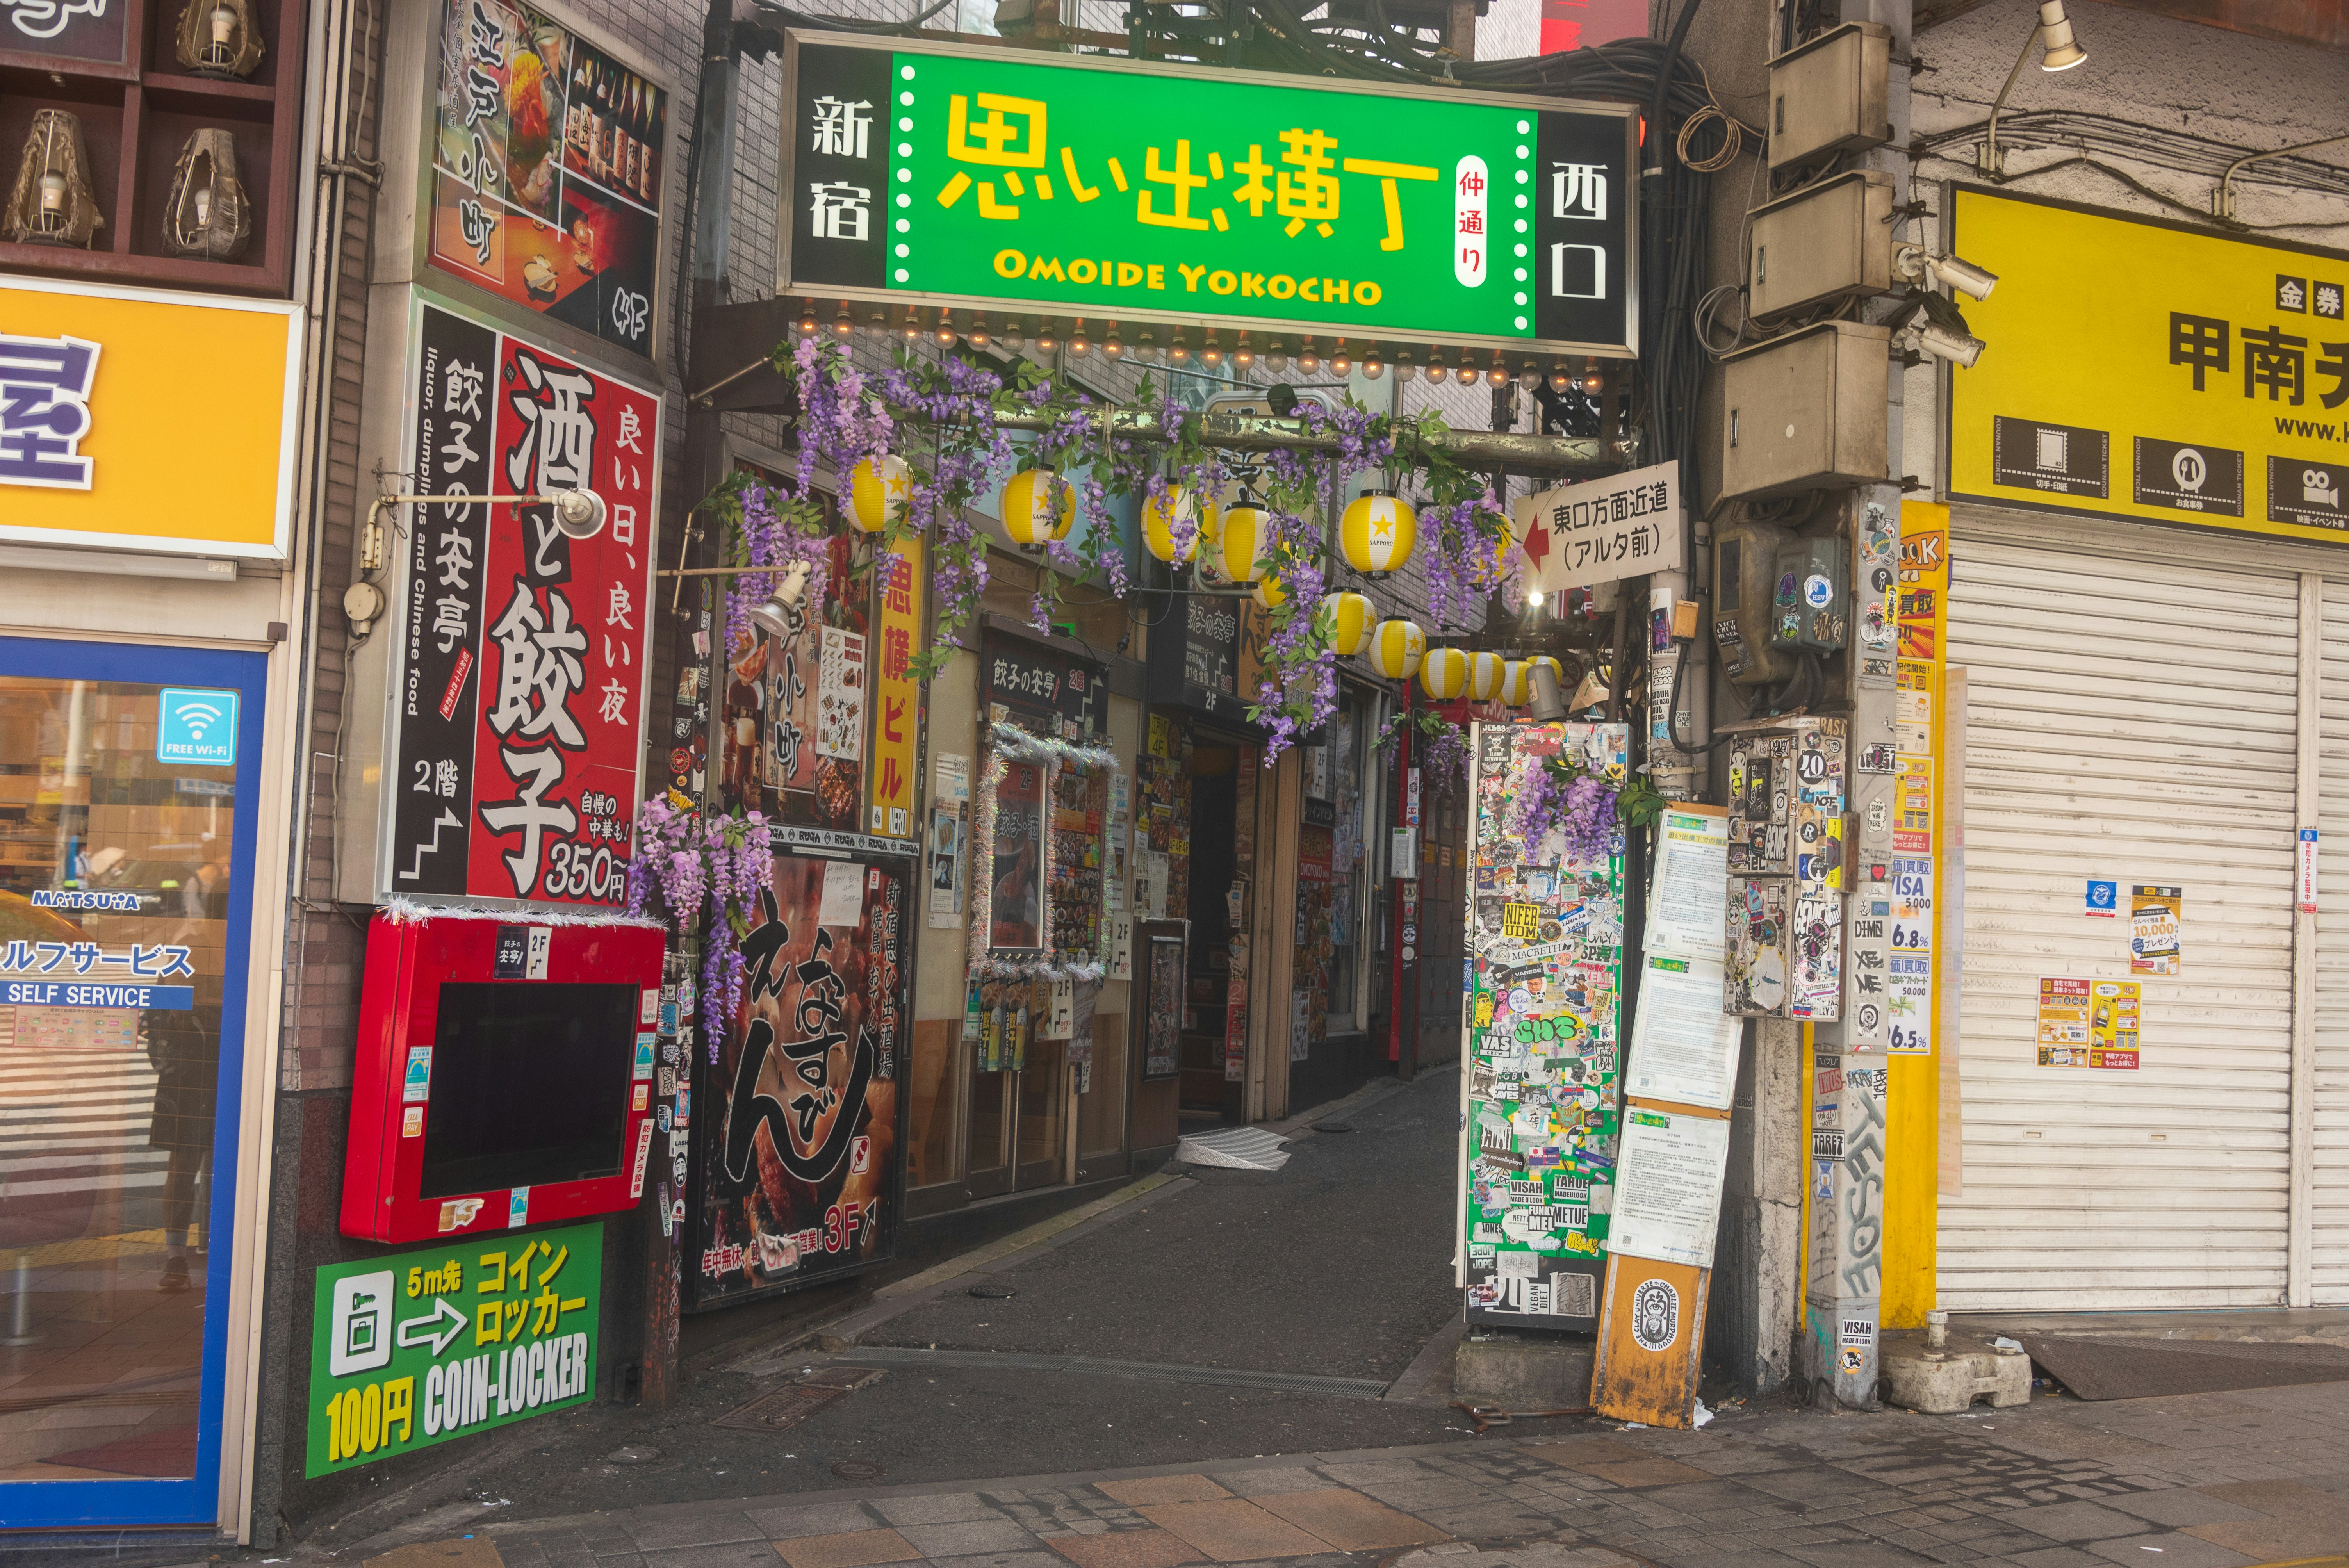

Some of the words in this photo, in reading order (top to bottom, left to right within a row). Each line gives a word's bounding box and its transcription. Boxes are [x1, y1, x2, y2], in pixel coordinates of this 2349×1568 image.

[810, 95, 873, 241] 新宿
[937, 92, 1439, 251] 思い出横丁
[1459, 171, 1484, 272] 仲通り
[1551, 161, 1608, 300] 西口
[993, 249, 1165, 291] OMOIDE
[1177, 262, 1382, 306] YOKOCHO
[424, 346, 438, 410] liquor,
[2035, 478, 2068, 492] 切手・印紙
[433, 358, 483, 653] 餃子の安亭
[1552, 480, 1668, 535] 東口方面近道
[2176, 498, 2203, 510] お食事券
[2297, 514, 2345, 529] 映画・イベント券
[415, 535, 426, 572] and
[1564, 523, 1659, 571] (アルタ前)
[597, 404, 644, 725] 良い日、良い夜
[1899, 593, 1932, 615] 買取
[411, 580, 426, 661] Chinese
[479, 349, 595, 895] 酒と餃子
[994, 658, 1055, 698] 餃子の安亭
[1727, 663, 1740, 672] AVOID
[880, 559, 913, 801] 思横ビル
[1069, 668, 1085, 693] 2階
[407, 668, 421, 716] food
[1205, 691, 1217, 711] 2F
[1300, 722, 1308, 739] 4F
[166, 743, 193, 755] FREE
[196, 745, 227, 756] Wi-Fi
[1152, 737, 1164, 755] 4F
[1318, 753, 1325, 767] 2F
[413, 759, 459, 798] 2階
[1020, 768, 1032, 790] 2F
[581, 791, 617, 816] 自慢の
[1871, 804, 1884, 813] JASON
[888, 807, 907, 836] NERO
[1765, 825, 1788, 860] GENIE
[1300, 862, 1322, 878] OMOYOKO
[1506, 904, 1538, 926] NIFER
[1564, 910, 1577, 918] VISITOR
[1117, 924, 1128, 940] 2F
[1505, 925, 1537, 938] UDM
[2133, 923, 2174, 938] 10,000
[2145, 935, 2178, 948] プレゼント!
[532, 935, 547, 952] 2F
[1511, 943, 1561, 960] MACBETH
[0, 940, 195, 977] ルフサービス
[499, 949, 520, 963] 安亭
[878, 878, 900, 1078] 新宿思ひ出酒場
[1514, 968, 1542, 976] VARESE
[9, 984, 58, 1003] SELF
[66, 986, 151, 1007] SERVICE
[1058, 979, 1069, 996] 2F
[1481, 1036, 1510, 1050] VAS
[1082, 1066, 1089, 1076] 2F
[1819, 1070, 1842, 1093] IWOS
[406, 1124, 419, 1132] PAY
[634, 1124, 651, 1193] 防犯カメラ設置
[1510, 1181, 1543, 1194] VISAH
[1554, 1190, 1587, 1199] MADEULOOK
[1529, 1205, 1554, 1216] FUNKY
[824, 1201, 859, 1254] 3F
[1529, 1216, 1554, 1231] MEL
[478, 1240, 568, 1294] コイン
[1473, 1258, 1494, 1269] JOPE
[406, 1260, 462, 1298] 5m先
[1530, 1285, 1539, 1313] VEGAN
[1539, 1289, 1548, 1308] DIET
[1635, 1281, 1653, 1312] UNIVERSE
[1659, 1282, 1676, 1311] CHARLIE
[476, 1286, 586, 1346] ロッカー
[1843, 1321, 1872, 1335] VISAH
[1636, 1334, 1647, 1347] THE
[423, 1331, 588, 1435] COIN-LOCKER
[326, 1376, 414, 1461] 100円
